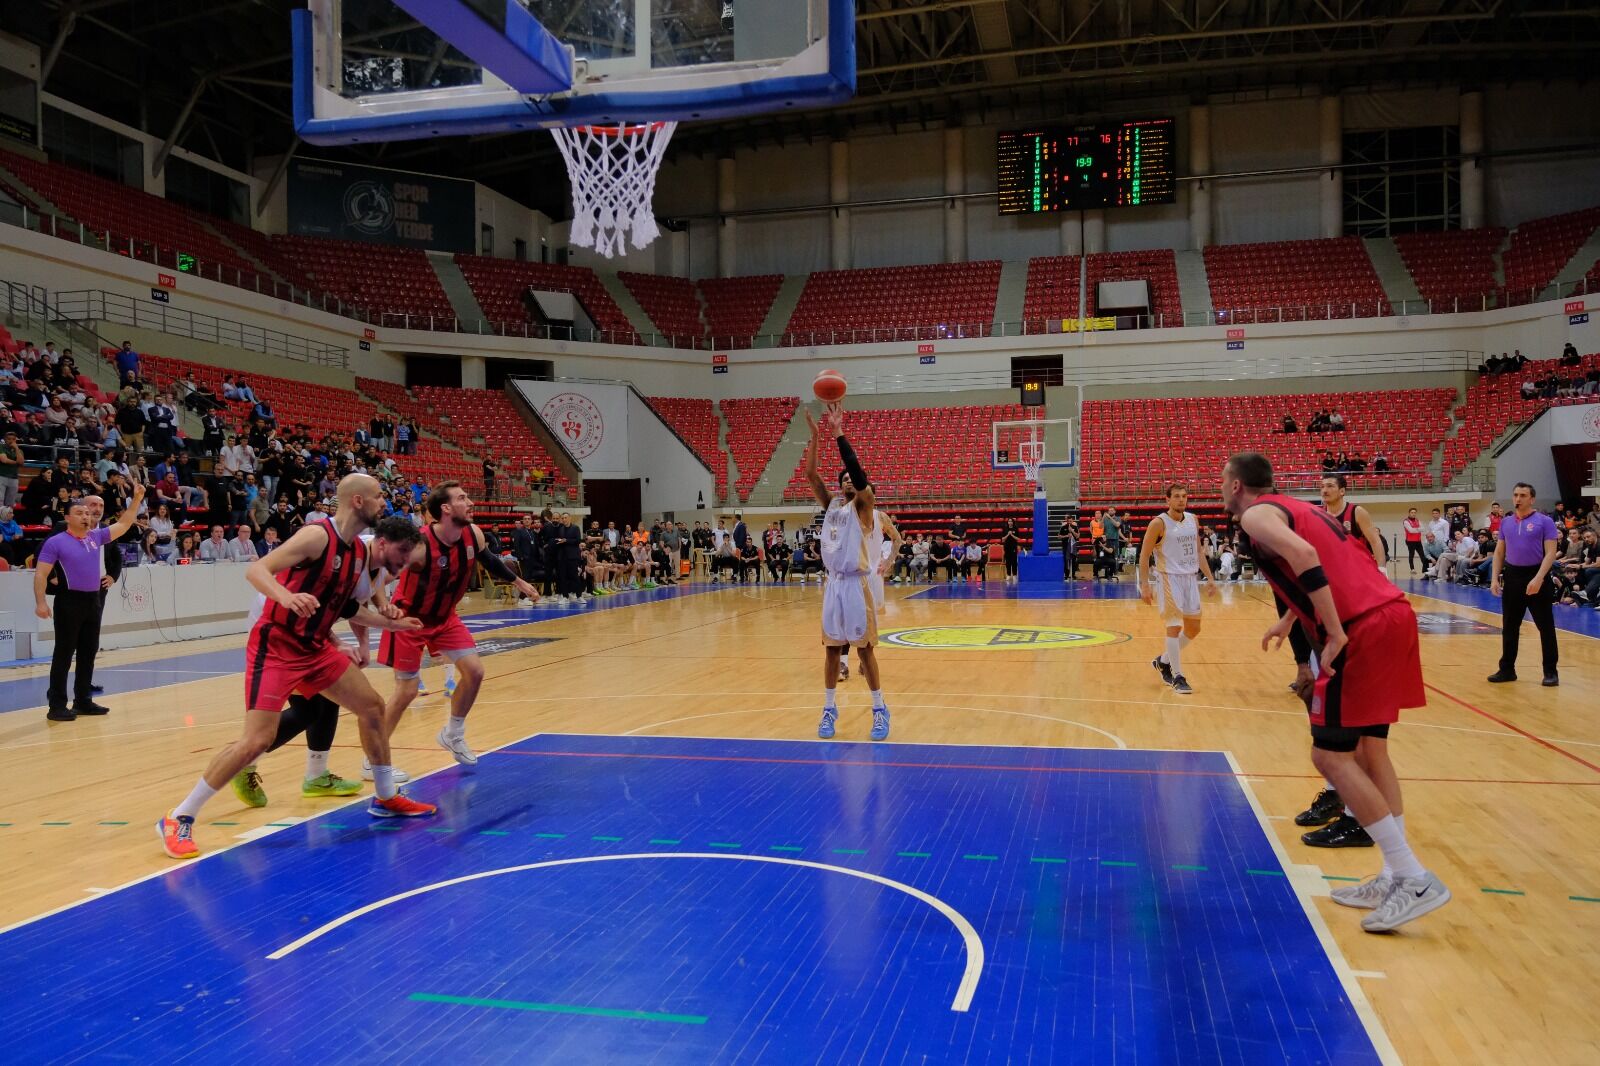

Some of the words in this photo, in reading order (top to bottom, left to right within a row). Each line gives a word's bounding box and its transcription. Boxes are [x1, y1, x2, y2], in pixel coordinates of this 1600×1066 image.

[1067, 136, 1079, 146] 77
[1100, 134, 1111, 144] 76
[1076, 157, 1092, 168] 19.9
[1083, 174, 1089, 182] 4
[394, 182, 429, 204] SPOR
[396, 221, 434, 241] YERDE
[160, 275, 170, 285] VIP
[153, 290, 163, 298] VIP
[1025, 383, 1038, 391] 19.9
[698, 490, 704, 502] A
[1183, 543, 1195, 557] 33
